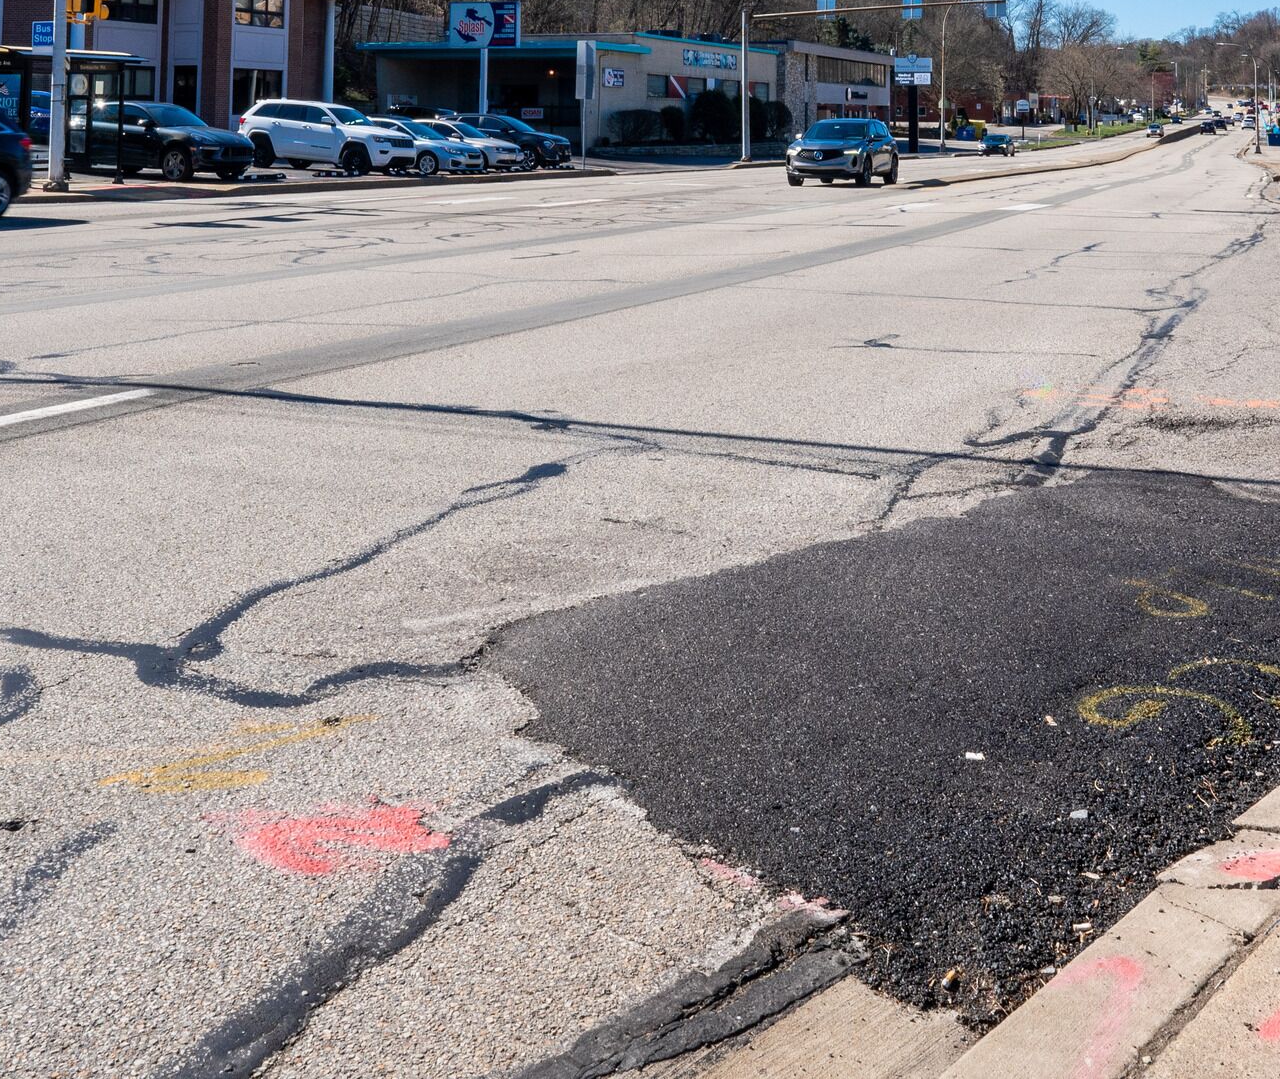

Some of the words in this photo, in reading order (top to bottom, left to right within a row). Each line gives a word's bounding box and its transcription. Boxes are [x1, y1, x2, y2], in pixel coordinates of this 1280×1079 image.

[35, 24, 51, 33] Bus
[458, 20, 485, 35] Splash
[34, 34, 53, 43] Stop
